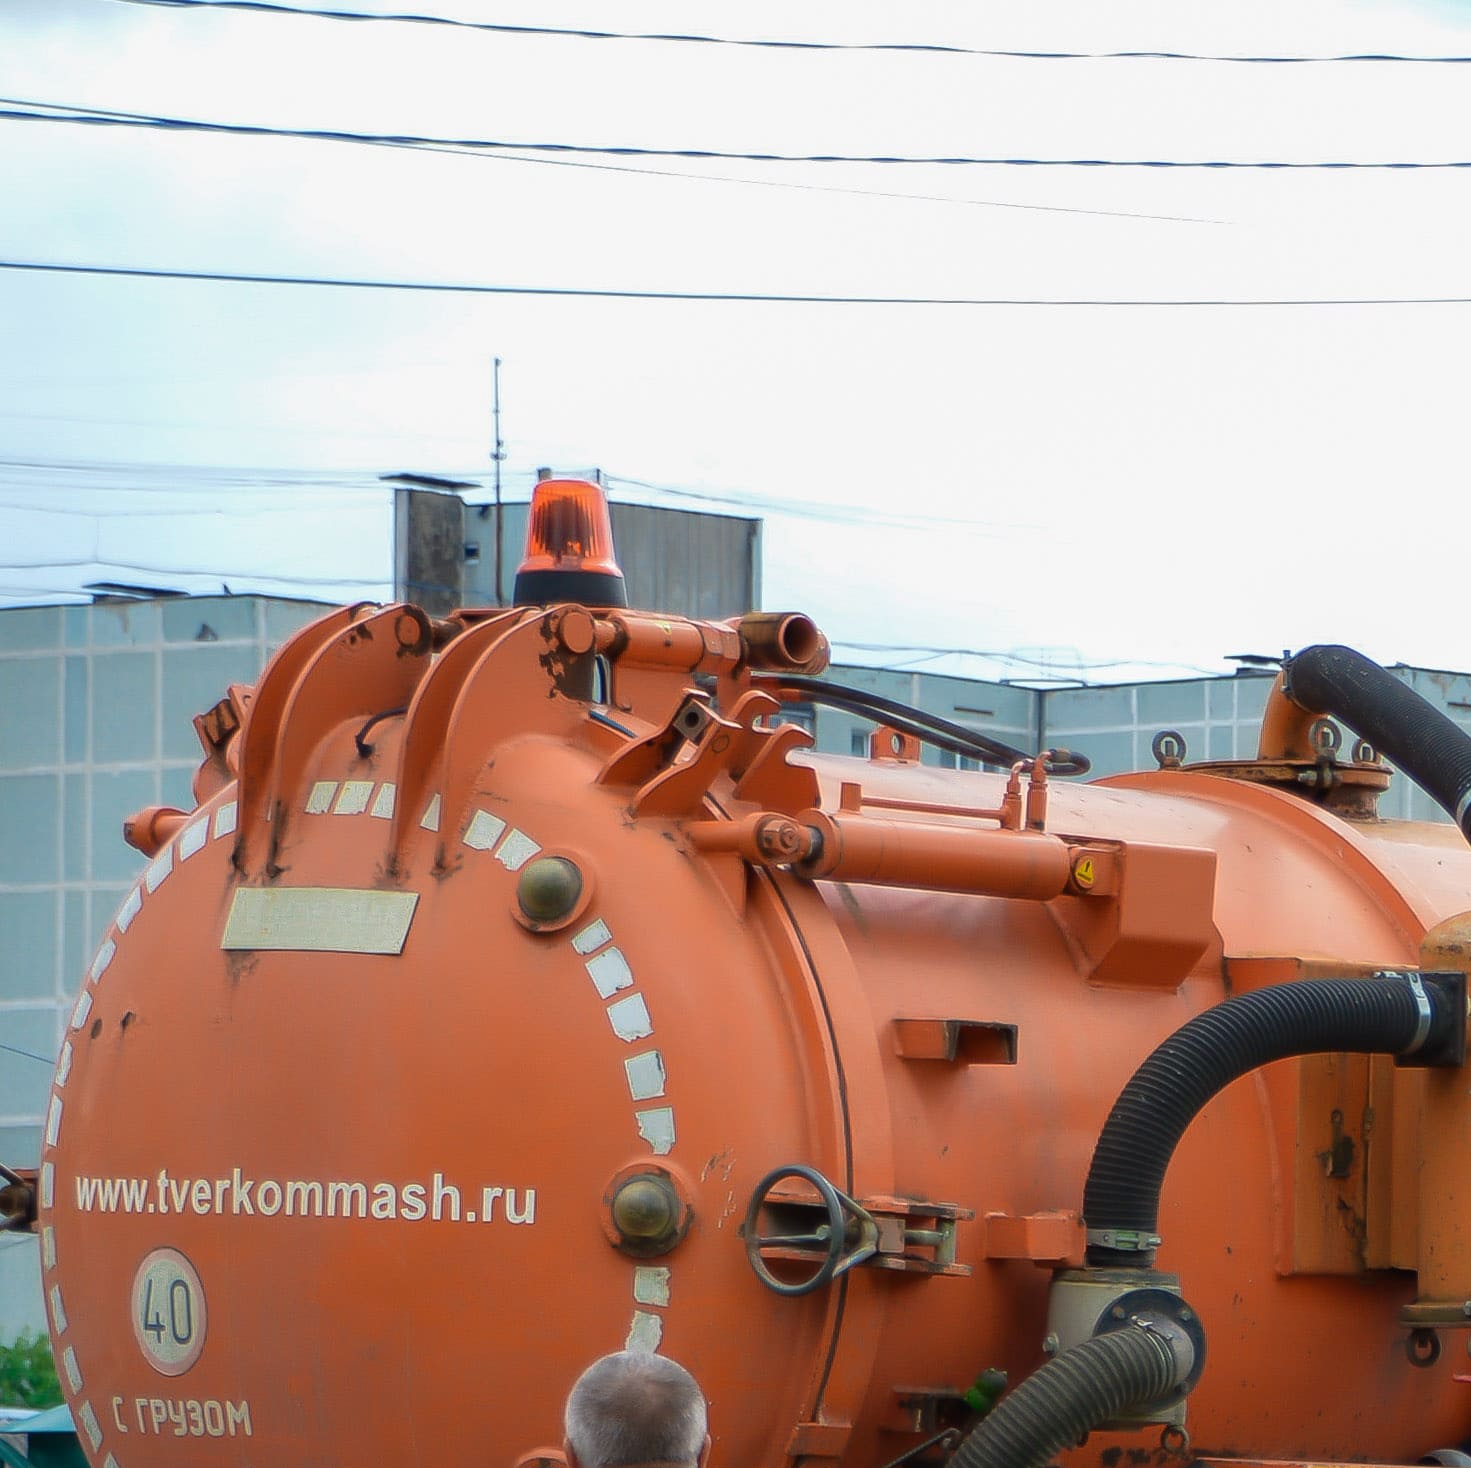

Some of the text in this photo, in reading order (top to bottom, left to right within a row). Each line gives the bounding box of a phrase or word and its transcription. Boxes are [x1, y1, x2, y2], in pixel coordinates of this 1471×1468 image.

[75, 1167, 536, 1224] www.tverkommash.ru
[142, 1278, 193, 1345] 40
[112, 1396, 253, 1437] С ГРУЗОМ
